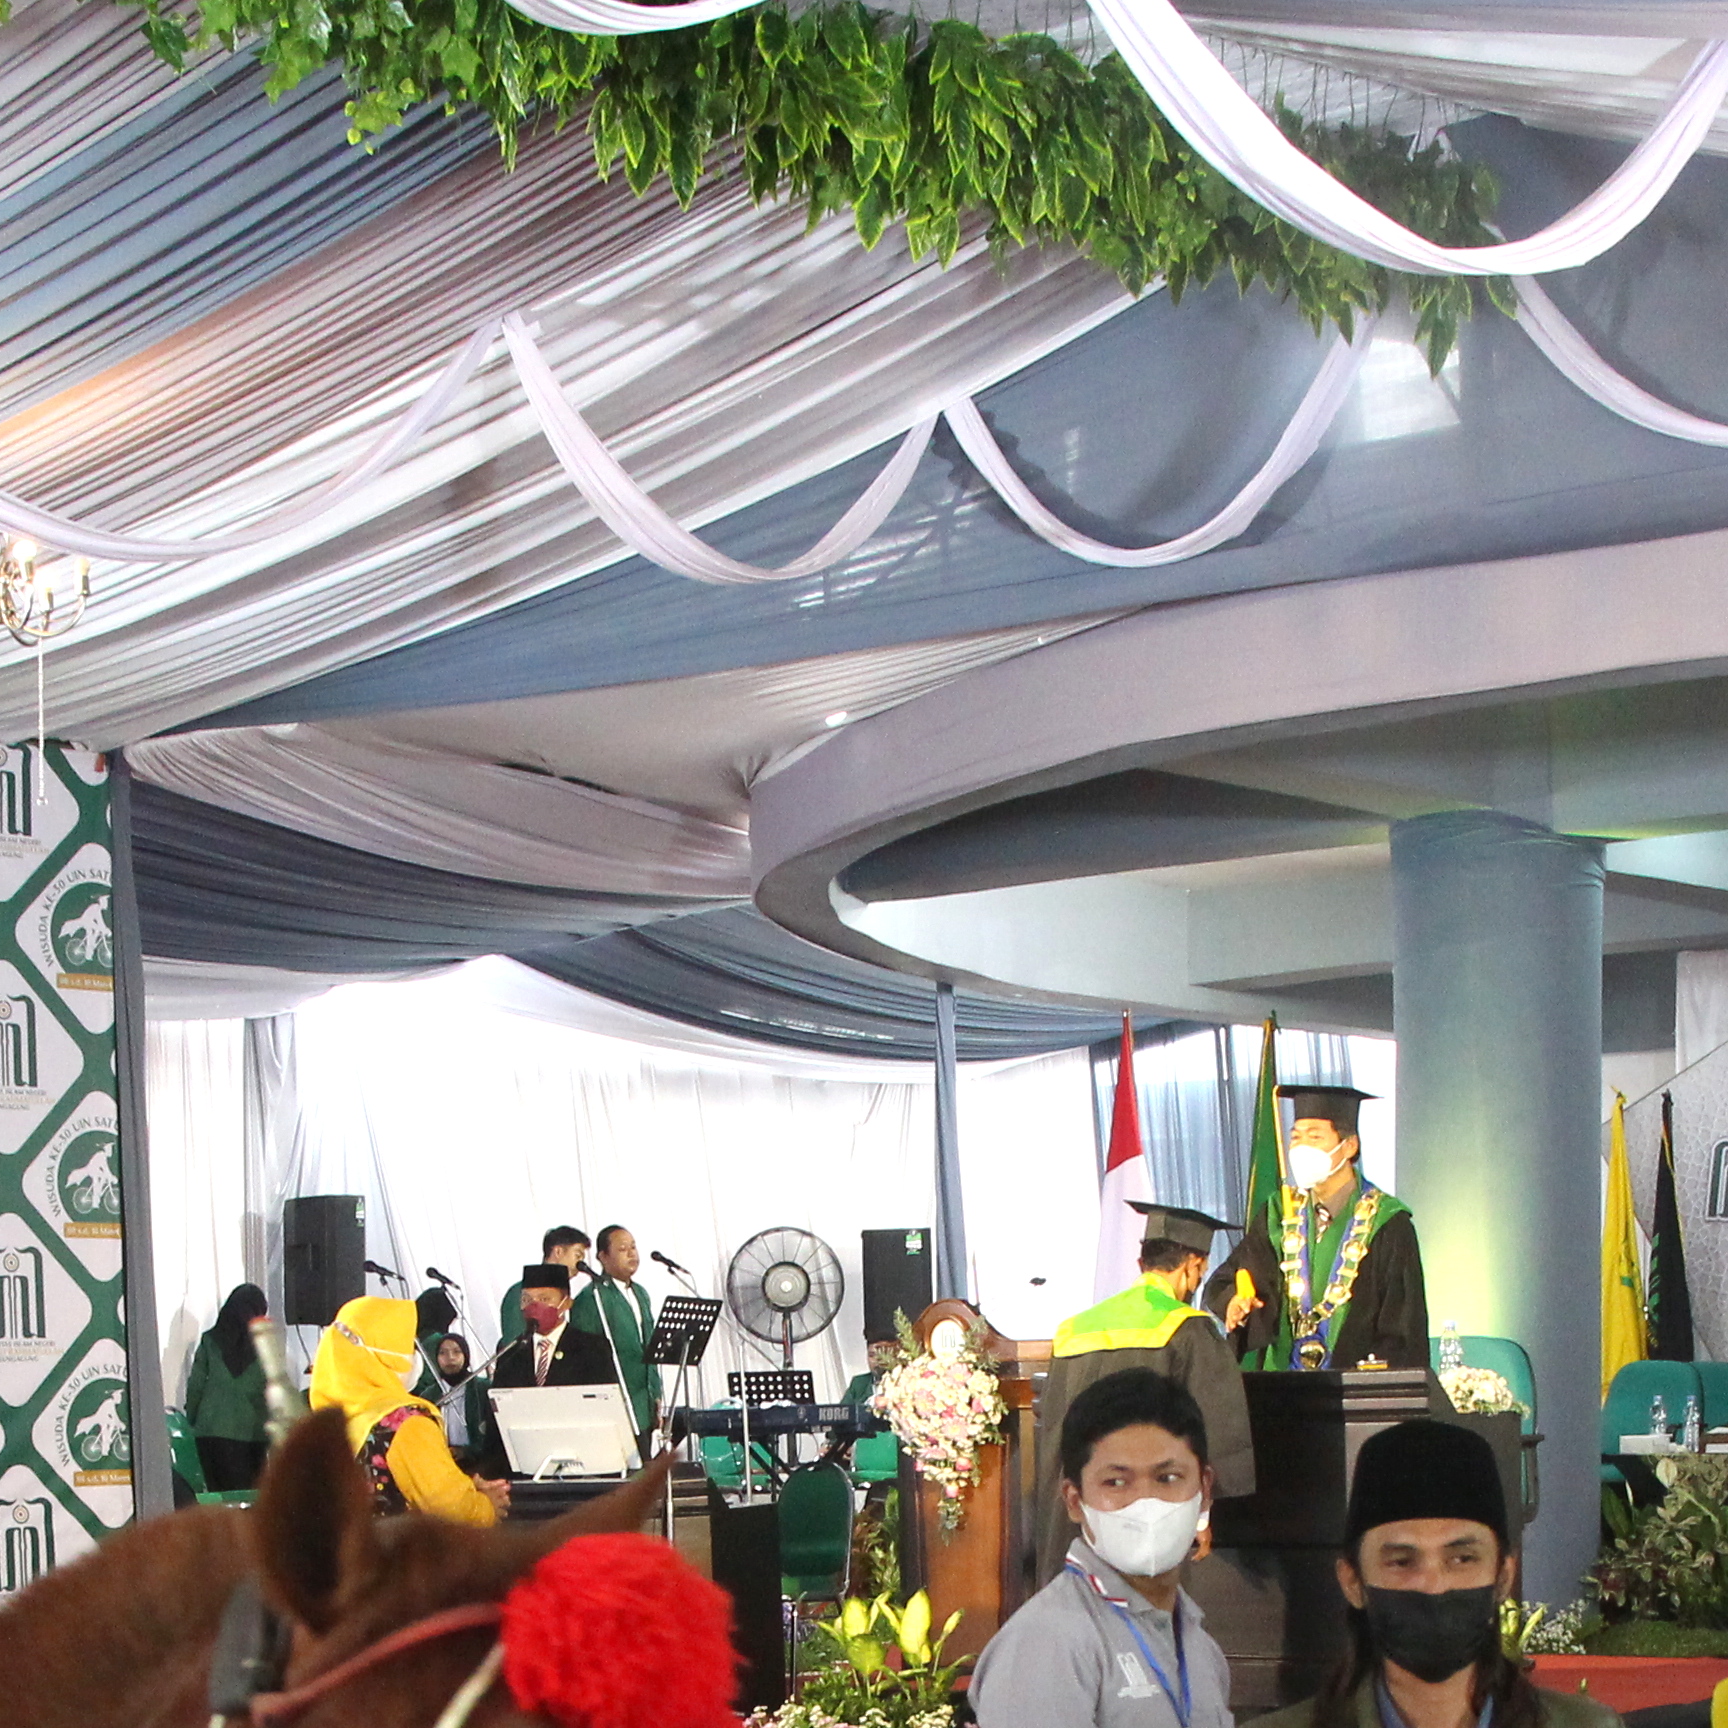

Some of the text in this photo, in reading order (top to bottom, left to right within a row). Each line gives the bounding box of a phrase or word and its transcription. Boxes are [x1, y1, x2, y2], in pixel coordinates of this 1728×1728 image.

[39, 868, 112, 966] WISUDA KE-30 UIN SAT
[72, 1118, 91, 1131] UIN
[49, 1130, 71, 1161] KE-30
[46, 1166, 61, 1217] WISUDA
[81, 1366, 100, 1380] UIN
[58, 1379, 79, 1410] KE-30
[818, 1406, 850, 1421] KORG
[55, 1415, 70, 1466] WISUDA
